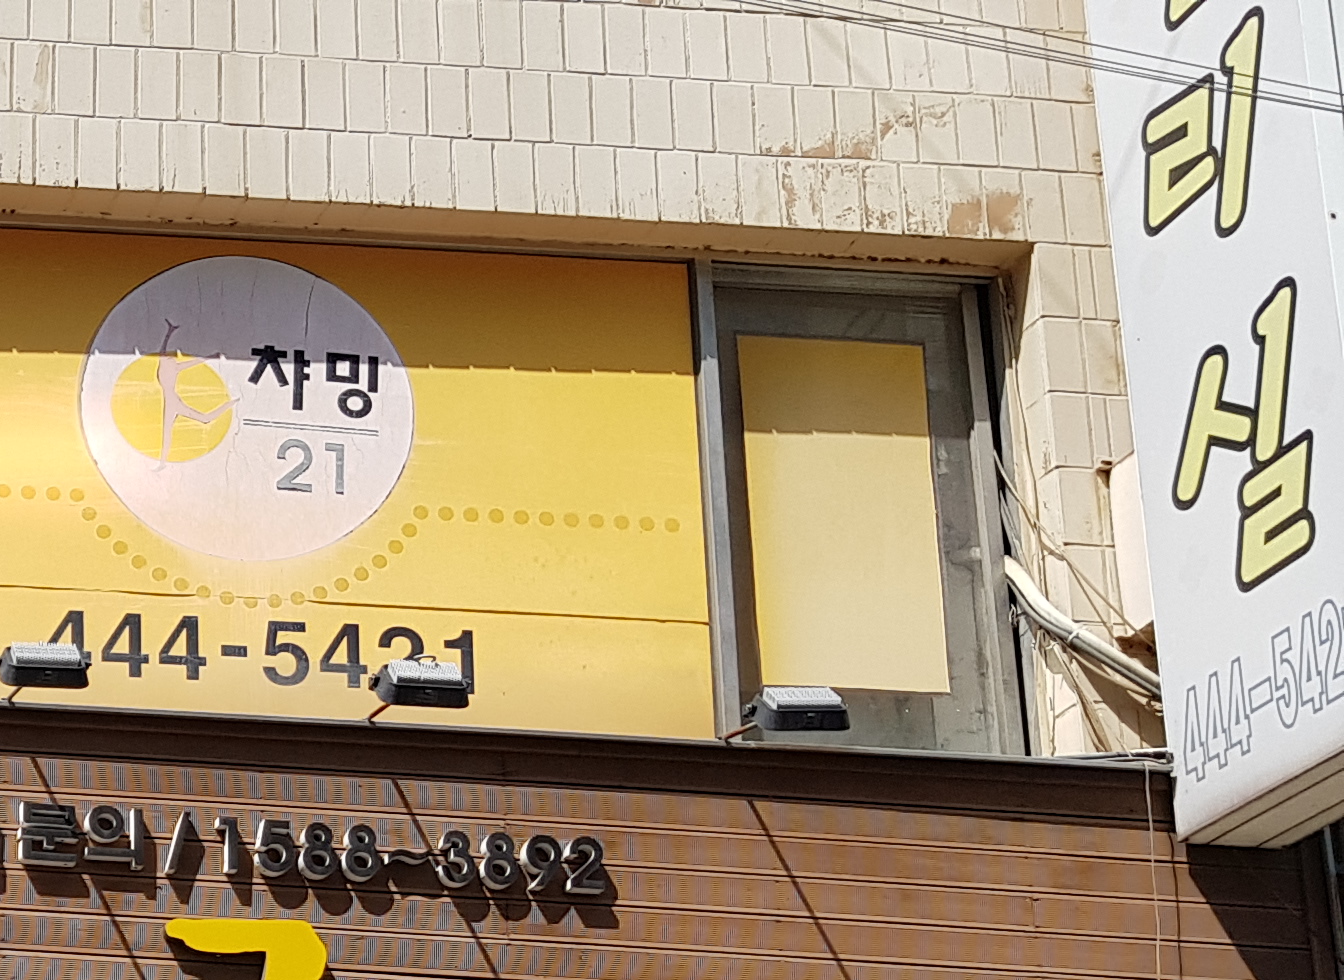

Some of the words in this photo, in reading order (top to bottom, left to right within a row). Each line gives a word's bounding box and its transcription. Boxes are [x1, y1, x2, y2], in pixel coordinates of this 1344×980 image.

[1142, 0, 1316, 592] 리실
[247, 345, 379, 418] 챠밍
[276, 439, 344, 495] 21
[1183, 599, 1344, 782] 444-542
[16, 800, 144, 870] 문의
